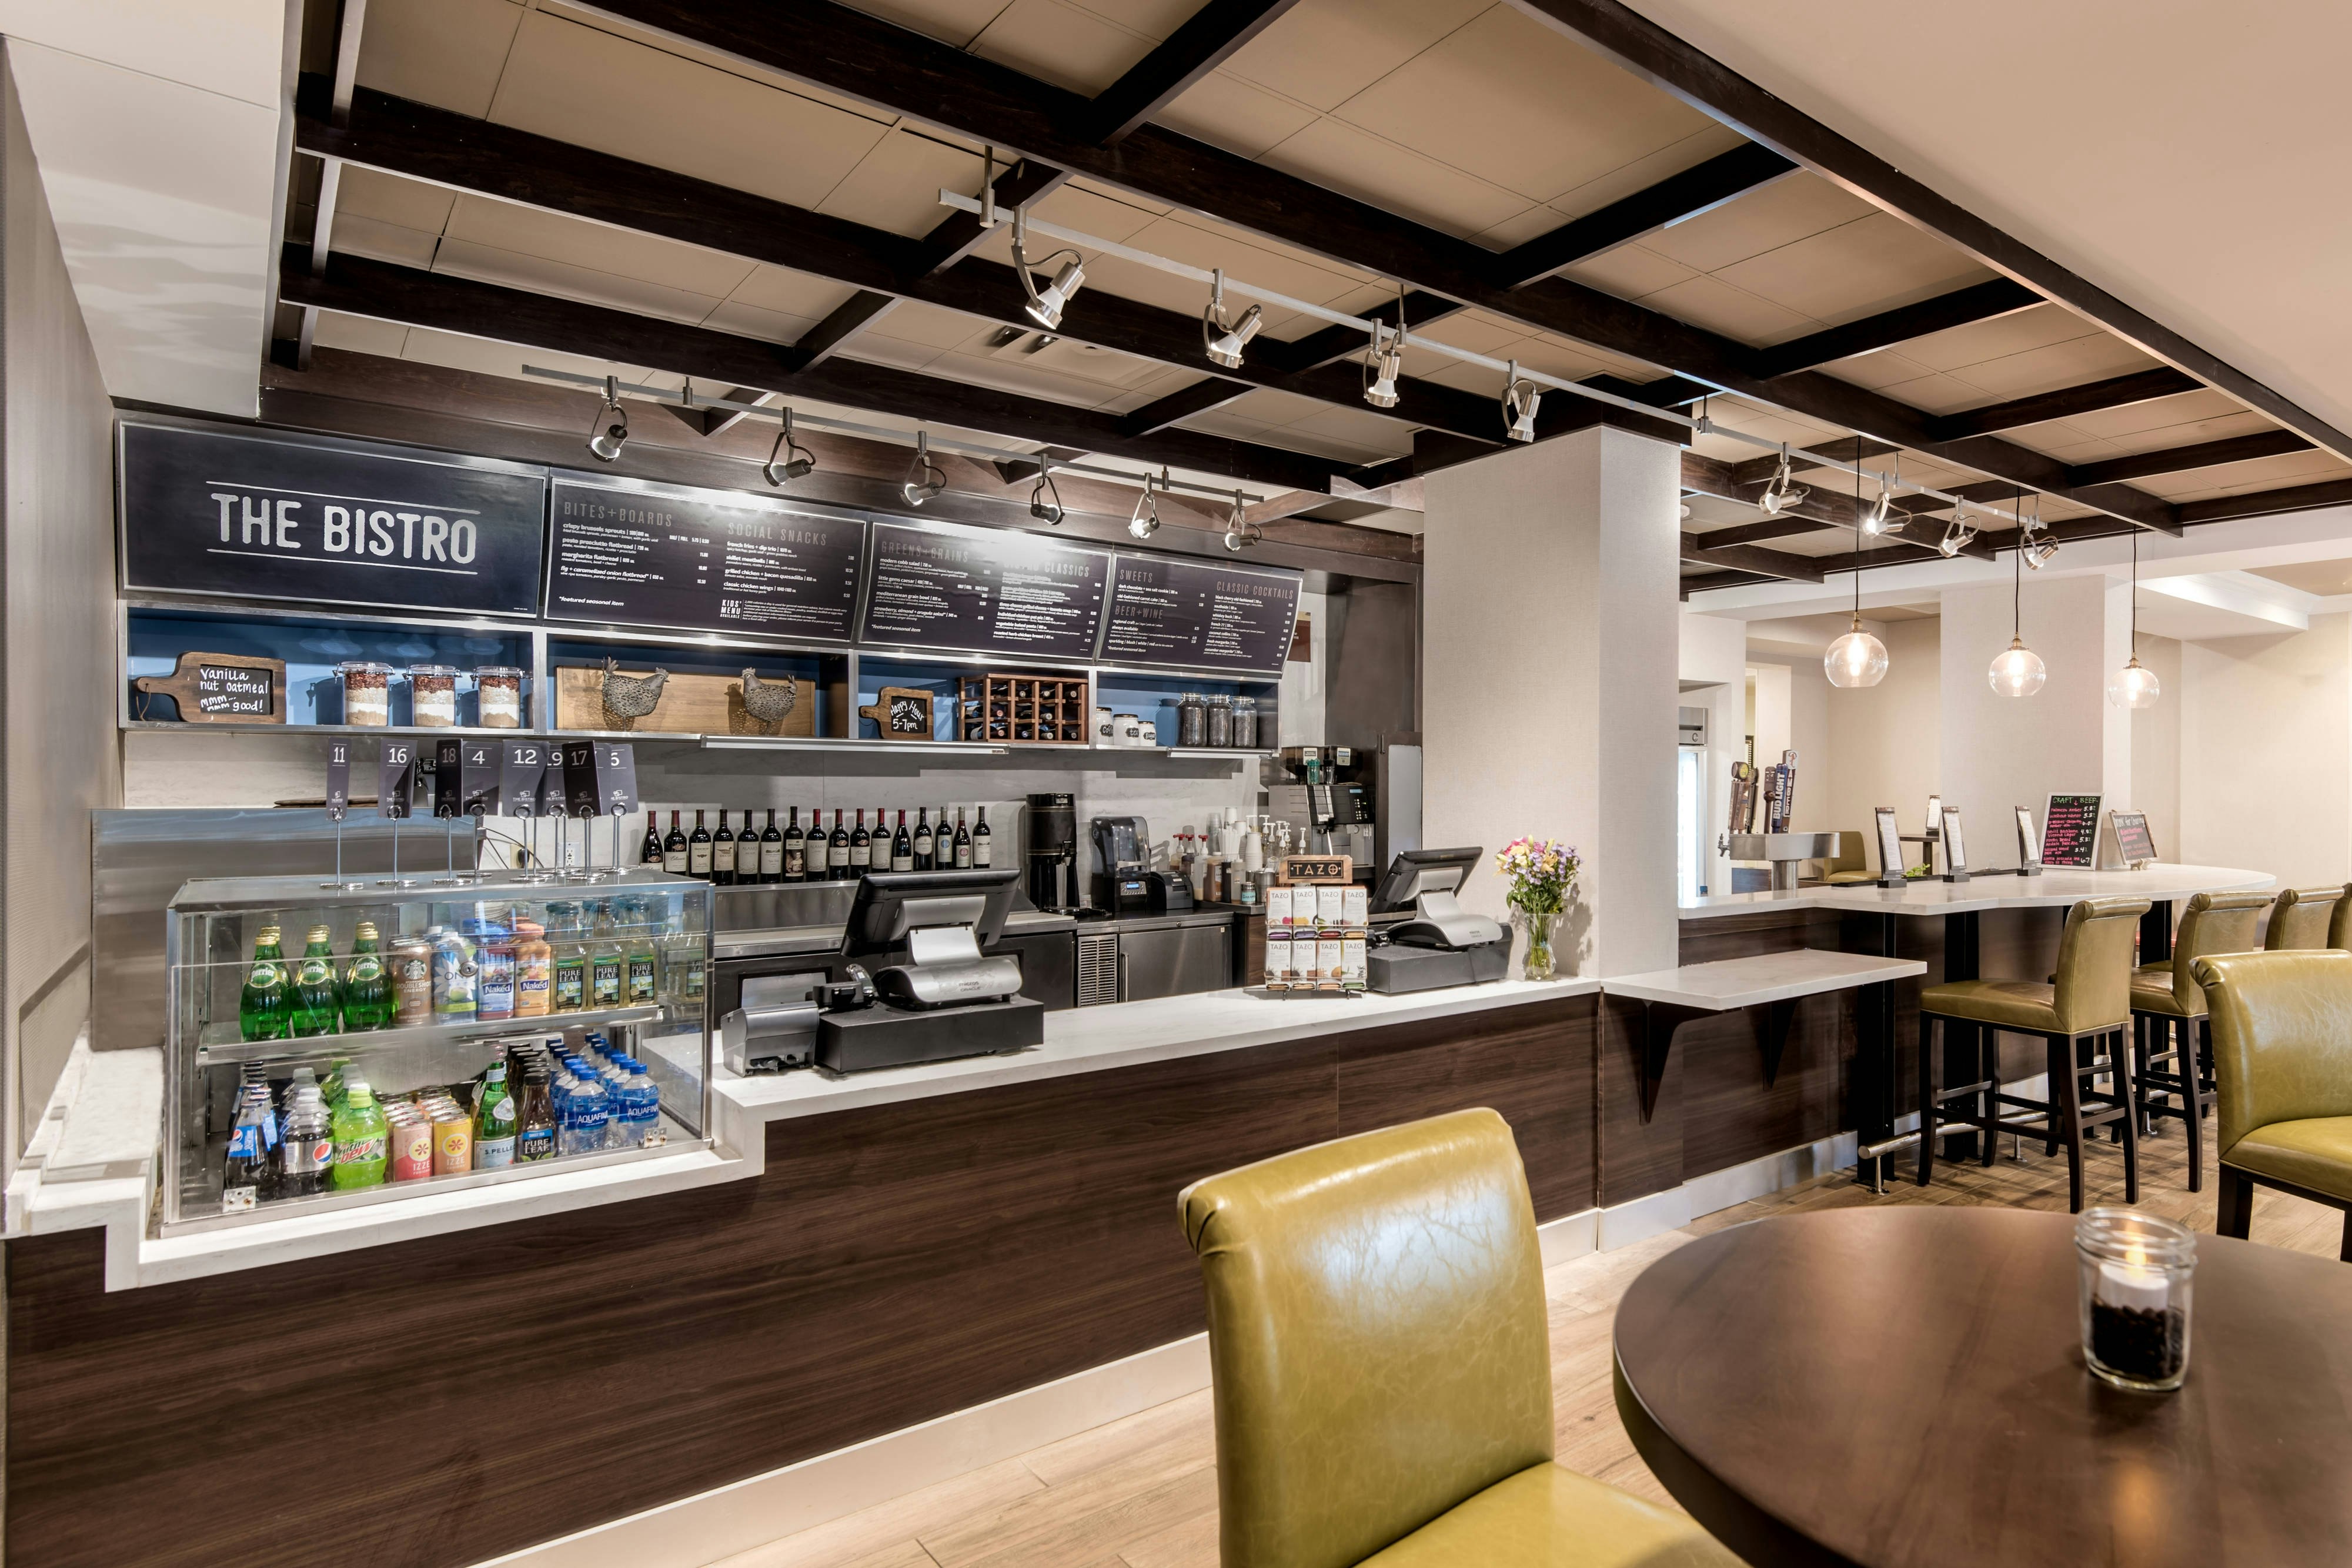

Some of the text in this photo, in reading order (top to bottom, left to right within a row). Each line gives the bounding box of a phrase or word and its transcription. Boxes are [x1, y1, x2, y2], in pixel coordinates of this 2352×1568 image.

[564, 501, 673, 527] BITES+BOARDS
[211, 493, 477, 564] THE BISTRO
[727, 522, 827, 546] SOCIAL SNACKS
[573, 566, 605, 574] caramelized
[1044, 561, 1090, 577] CLASSICS
[1119, 569, 1153, 583] SWEETS
[1215, 581, 1294, 599] CLASSIC COCKTAILS
[1114, 605, 1163, 618] BEER+WINE
[201, 668, 249, 681] Vanilla
[201, 680, 268, 694] nut oatmeal
[233, 700, 263, 712] good!
[891, 701, 924, 721] Happy Hour
[893, 718, 918, 731] 5-7pm
[333, 747, 346, 763] 11
[389, 748, 407, 764] 16
[442, 748, 456, 763] 18
[472, 751, 485, 764] 4
[514, 749, 537, 764] 12
[571, 750, 587, 765] 17
[1773, 773, 1785, 819] BUD LIGHT
[1293, 864, 1338, 875] TAZO
[445, 972, 467, 980] ON
[485, 985, 510, 994] Naked
[522, 981, 547, 990] Naked
[485, 1144, 516, 1155] S.PELLE
[524, 1138, 549, 1148] PURE
[524, 1146, 549, 1154] LEAF
[413, 1160, 430, 1171] IZZE
[447, 1156, 465, 1165] IZZE
